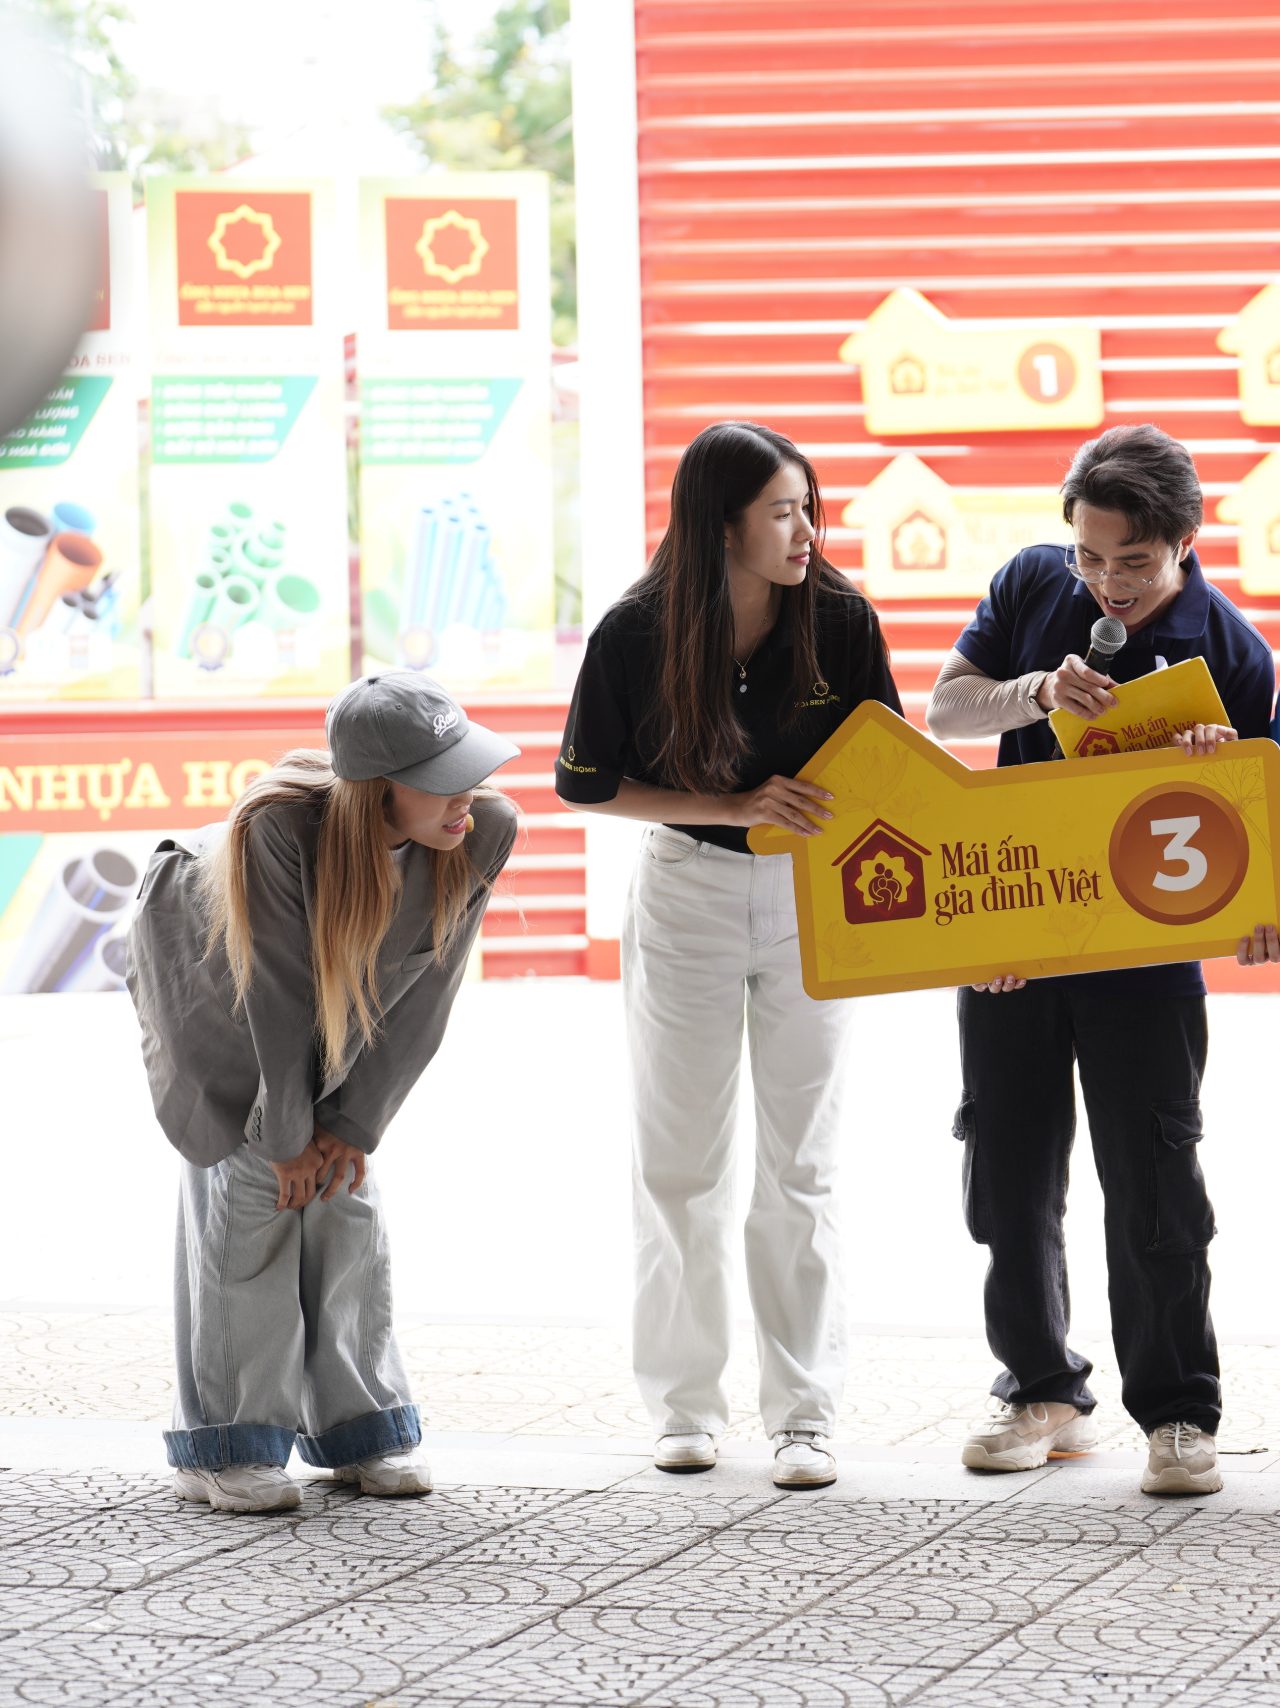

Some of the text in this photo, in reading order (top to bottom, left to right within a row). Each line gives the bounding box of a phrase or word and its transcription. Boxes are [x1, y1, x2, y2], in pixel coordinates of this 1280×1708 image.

[1032, 353, 1060, 398] 1
[1120, 715, 1168, 742] Mái ấm
[0, 757, 171, 821] NHỰA
[940, 835, 1040, 879] Mái ấm
[1150, 816, 1208, 892] 3
[934, 868, 1104, 926] gia đình Việt
